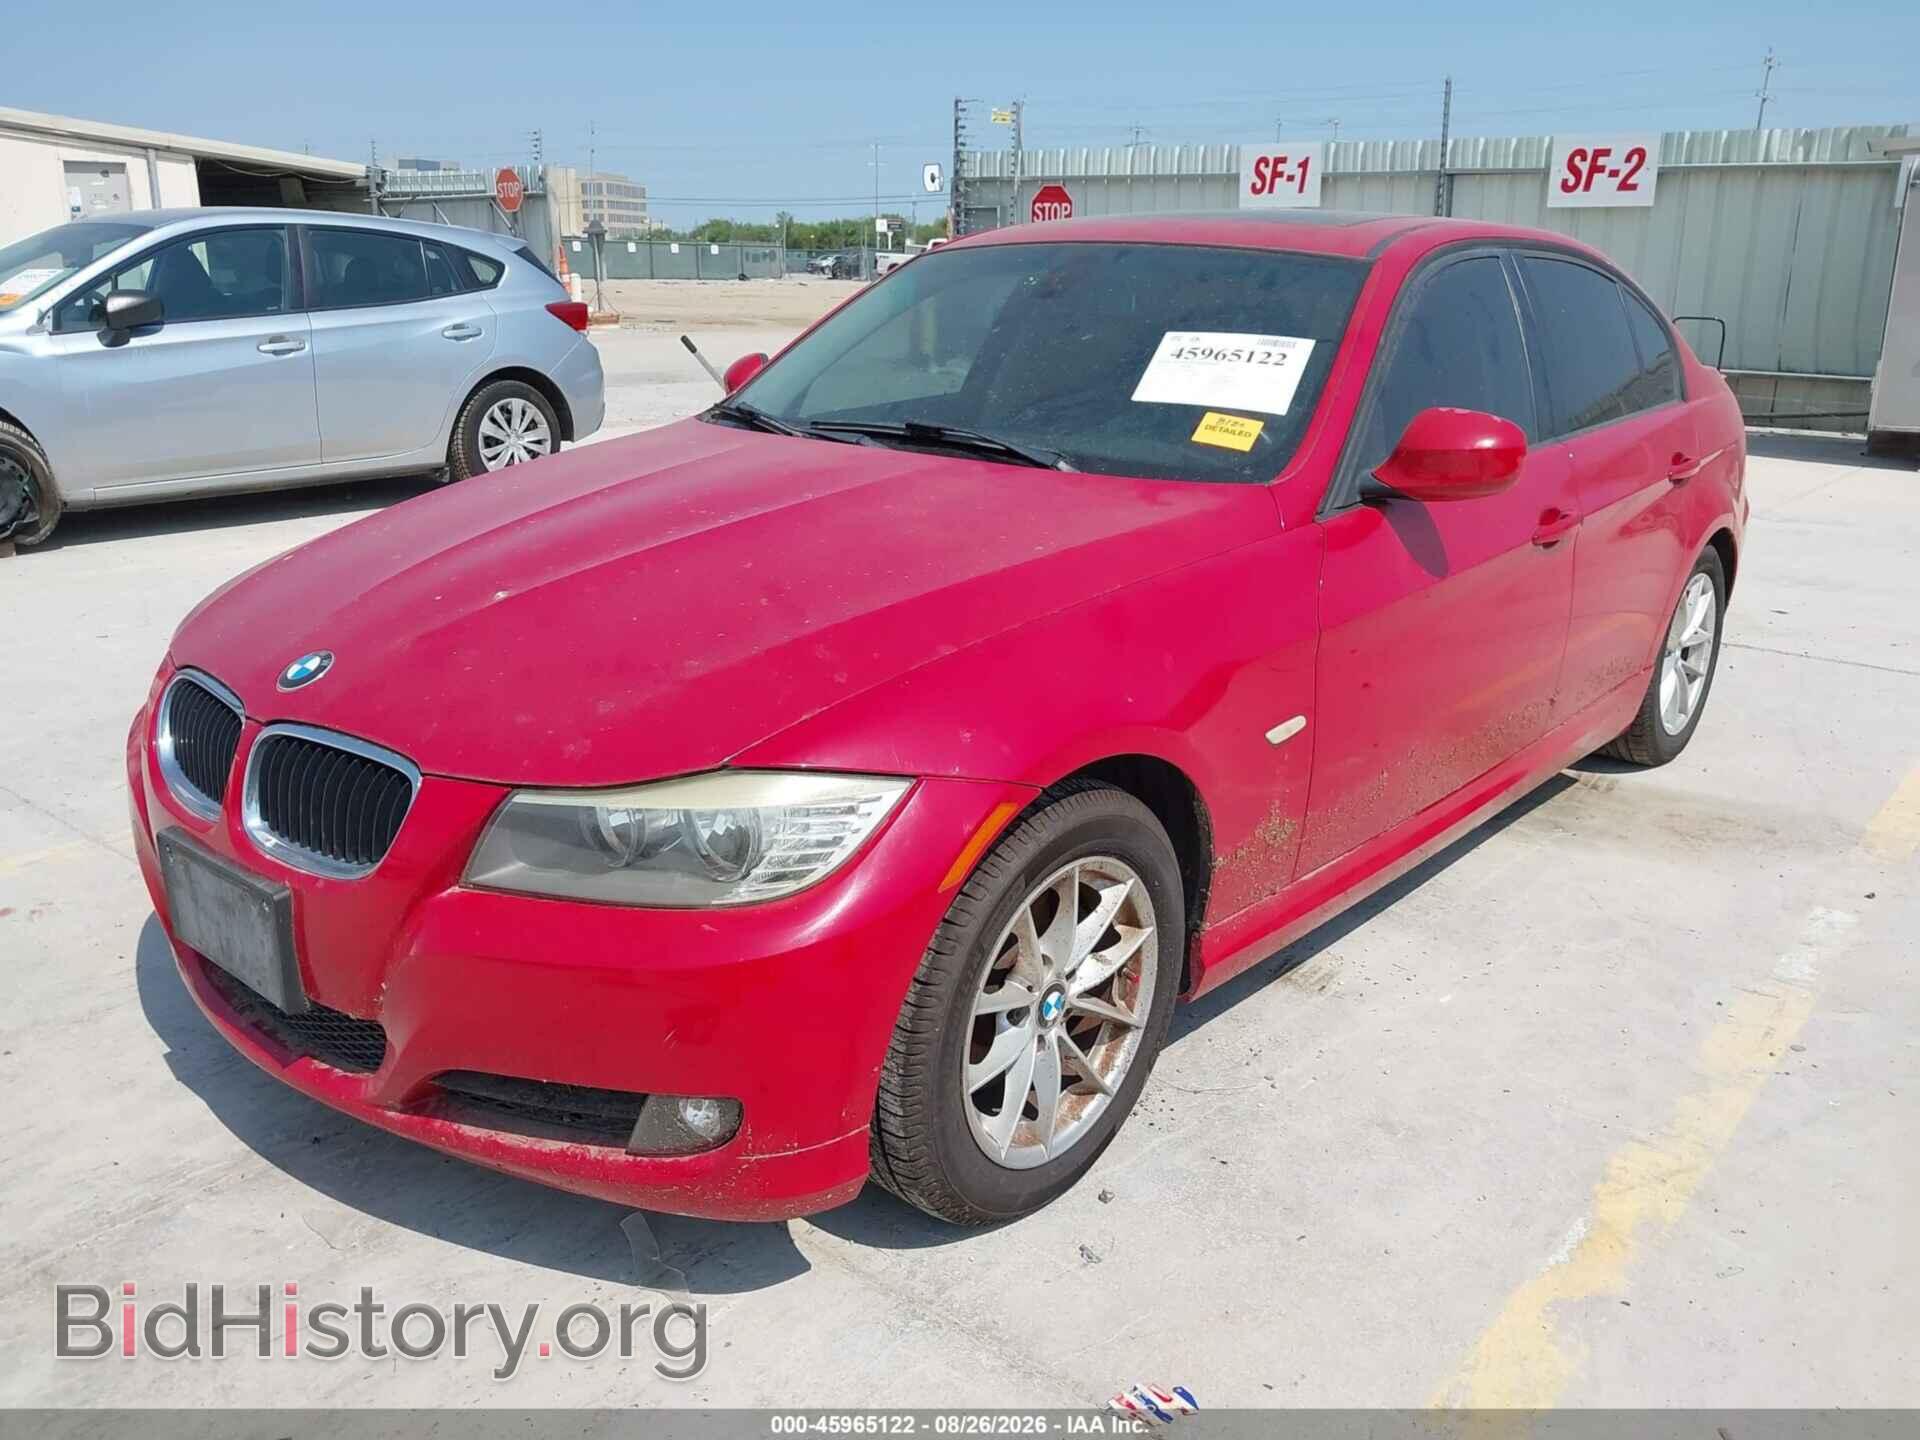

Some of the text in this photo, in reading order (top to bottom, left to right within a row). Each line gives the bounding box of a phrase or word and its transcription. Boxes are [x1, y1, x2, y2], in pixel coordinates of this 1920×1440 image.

[1250, 156, 1310, 195] SF-1
[1561, 147, 1647, 193] SF-2
[497, 182, 520, 198] STOP
[1033, 202, 1071, 222] STOP
[1169, 346, 1288, 367] 45965122
[1203, 423, 1253, 438] DETAILED
